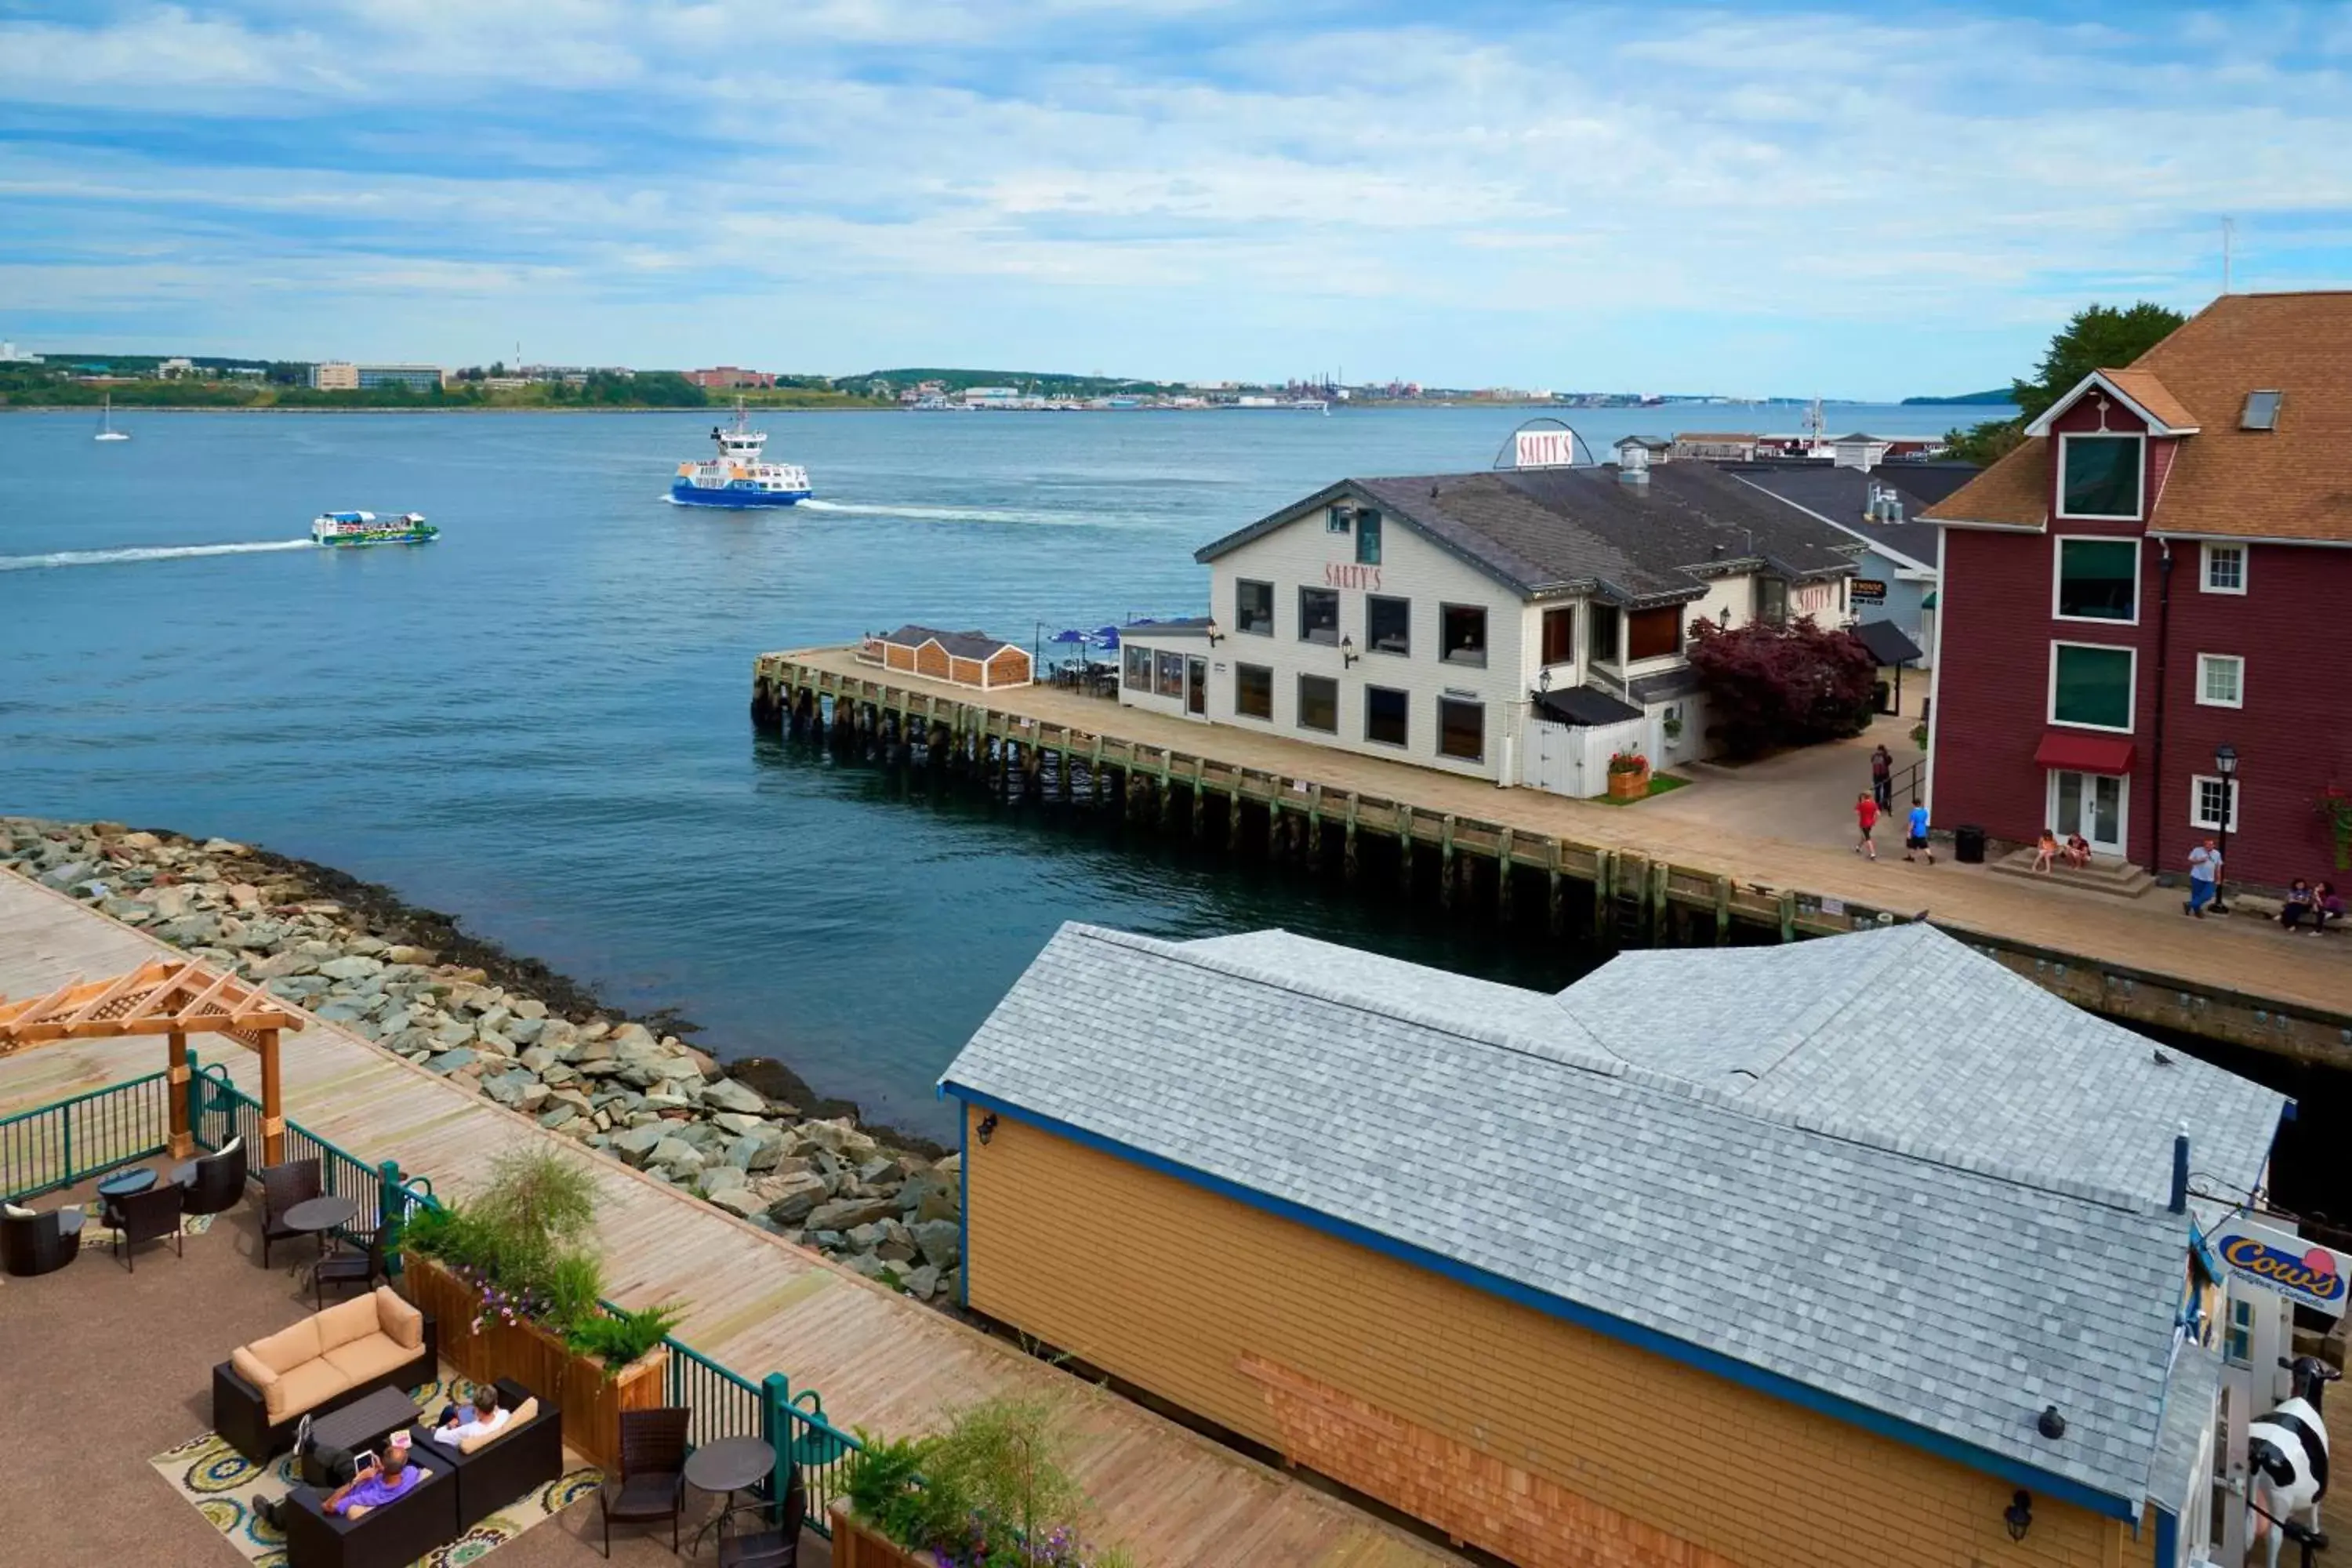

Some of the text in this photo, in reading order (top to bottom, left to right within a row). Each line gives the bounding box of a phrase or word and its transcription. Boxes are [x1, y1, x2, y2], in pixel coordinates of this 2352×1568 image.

[1519, 434, 1571, 463] SALTY'S
[1325, 563, 1381, 591] SALTY'S
[2278, 1287, 2326, 1308] Canada
